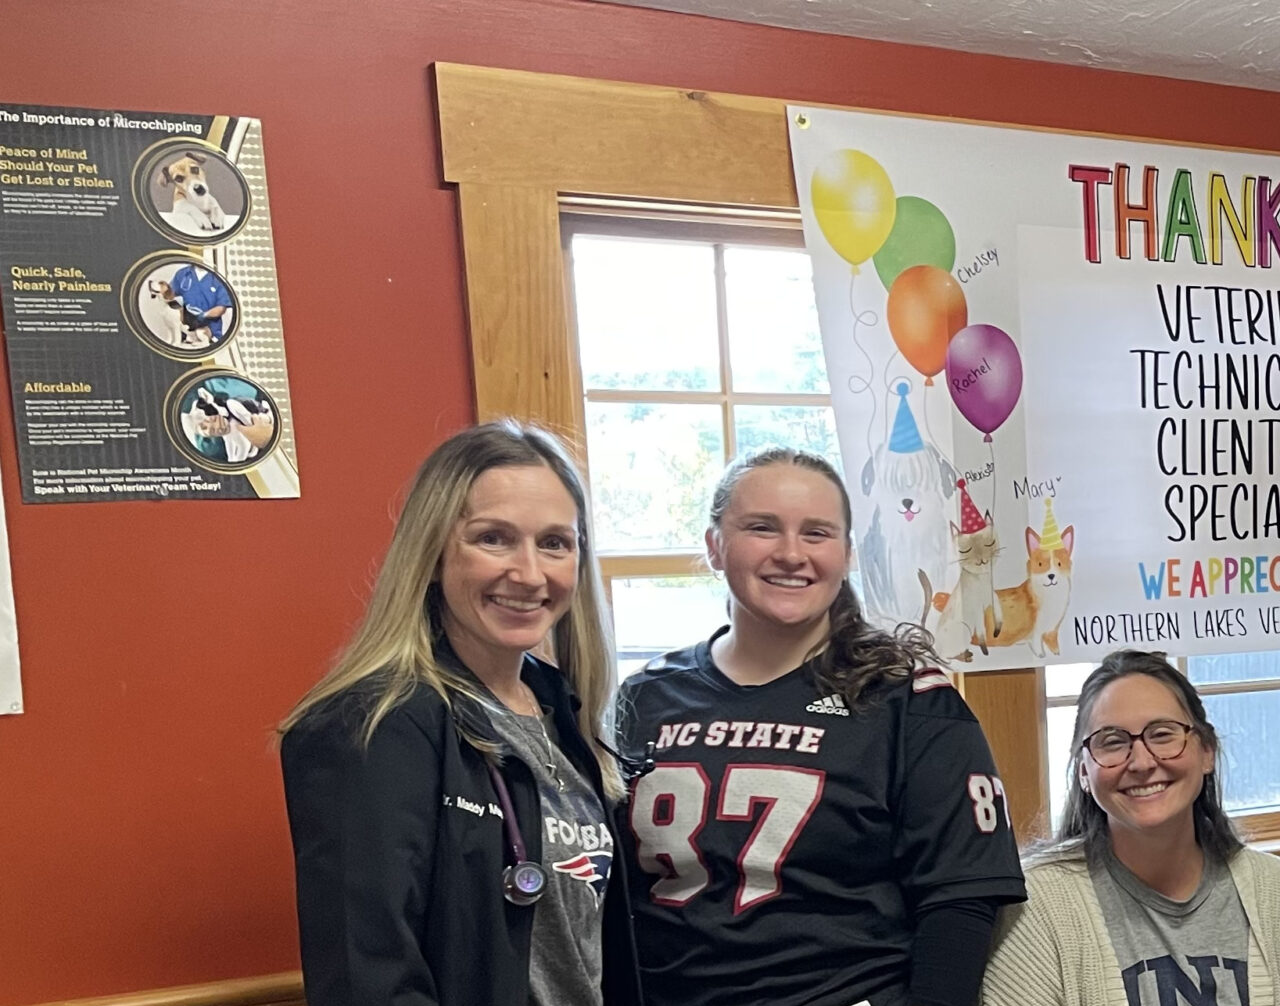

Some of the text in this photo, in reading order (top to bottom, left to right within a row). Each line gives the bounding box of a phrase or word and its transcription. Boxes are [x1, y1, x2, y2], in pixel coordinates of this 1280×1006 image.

[0, 110, 202, 134] The Importance of Microchipping
[0, 146, 87, 160] Peace of Mind
[0, 160, 98, 174] Should Your Pet
[1, 174, 114, 188] Get Lost or Stolen
[11, 266, 86, 279] Quick, Safe,
[957, 248, 1000, 284] Chelsey
[12, 280, 112, 293] Nearly Painless
[952, 357, 993, 393] Rachel
[24, 382, 91, 393] Affordable
[34, 481, 221, 495] Speak with Your Veterinary Team Today!
[1014, 476, 1056, 499] Mary
[1138, 558, 1181, 600] WE
[1074, 611, 1180, 645] NORTHERN
[1193, 608, 1247, 639] LAKES
[806, 704, 849, 717] adidas
[655, 721, 825, 754] NC STATE
[629, 762, 826, 917] 87
